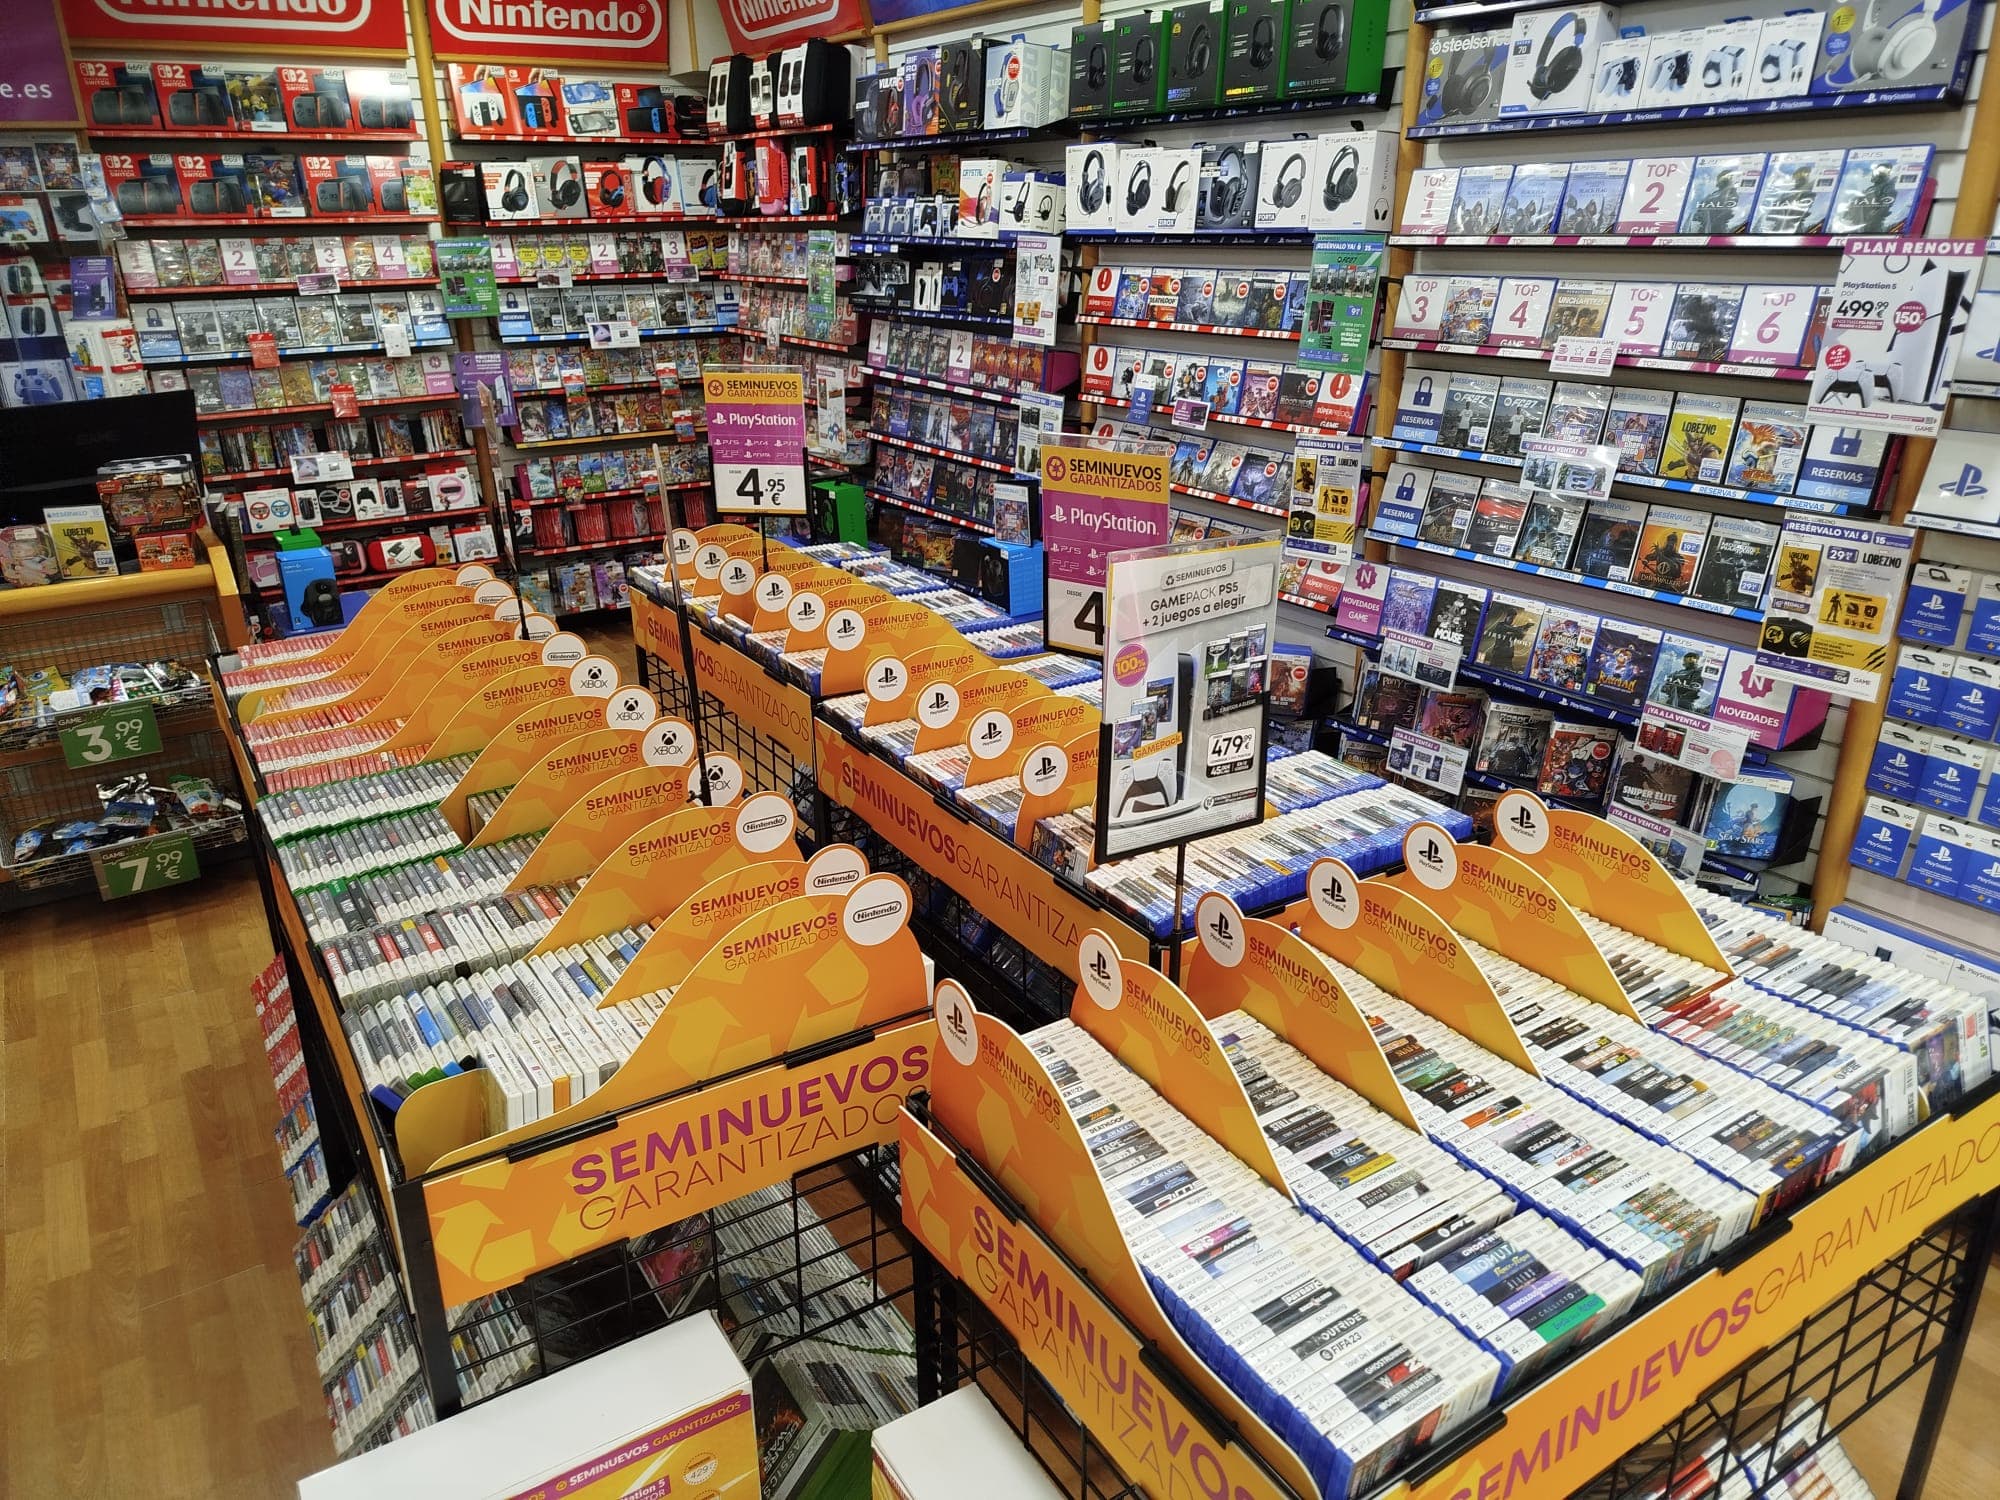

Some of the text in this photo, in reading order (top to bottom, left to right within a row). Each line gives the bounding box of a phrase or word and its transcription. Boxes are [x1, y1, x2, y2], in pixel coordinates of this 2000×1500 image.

[460, 0, 642, 33] Nintendo
[96, 63, 109, 77] 2
[173, 64, 186, 79] 2
[296, 69, 308, 83] 2
[121, 156, 133, 170] 2
[194, 157, 207, 171] 2
[321, 157, 333, 171] 2
[1646, 163, 1678, 178] TOP
[1639, 182, 1666, 214] 2
[225, 240, 246, 248] TOP
[381, 244, 395, 260] 4
[496, 243, 507, 258] 1
[598, 241, 610, 257] 2
[669, 238, 679, 255] 3
[1851, 241, 1976, 255] PLAN RENOVE
[232, 249, 246, 267] 2
[1414, 280, 1438, 293] TOP
[1514, 284, 1540, 298] TOP
[1630, 288, 1660, 302] TOP
[1843, 282, 1897, 291] PlayStation 5
[1411, 296, 1430, 323] 3
[1761, 292, 1797, 307] TOP
[1508, 300, 1528, 329] 4
[1624, 305, 1648, 336] 5
[1756, 311, 1782, 344] 6
[955, 345, 964, 364] 2
[726, 379, 799, 390] SEMINUEVOS
[727, 390, 799, 399] GARANTIZADOS
[729, 413, 798, 429] PlayStation
[1400, 414, 1435, 427] RESERVAS
[1403, 429, 1426, 439] GAME
[1069, 458, 1162, 481] SEMINUEVOS
[1811, 466, 1864, 483] RESERVAS
[1069, 472, 1162, 493] GARANTIZADOS
[1814, 487, 1849, 500] GAME
[1383, 508, 1415, 520] RESERVAS
[1783, 499, 1825, 511] RESERVAS
[1070, 505, 1158, 536] PlayStation
[1786, 522, 1886, 545] ¡RESÉRVALO YA! 15
[1830, 550, 1844, 560] 29
[1175, 563, 1227, 582] SEMINUEVOS
[387, 579, 453, 596] SEMINUEVOS
[794, 575, 853, 591] SEMINUEVOS
[403, 595, 472, 613] SEMINUEVOS
[828, 593, 888, 610] SEMINUEVOS
[1150, 581, 1239, 612] GAMEPACK PS5
[1342, 596, 1380, 612] NOVEDADES
[867, 611, 929, 628] SEMINUEVOS
[1073, 590, 1104, 646] 4
[1152, 593, 1247, 630] 2 juegos elegir
[1348, 610, 1369, 624] GAME
[420, 614, 491, 632] SEMINUEVOS
[867, 619, 930, 635] GARANTIZADOS
[437, 631, 512, 652] SEMINUEVOS
[1434, 628, 1464, 645] MOUSE
[461, 651, 539, 673] SEMINUEVOS
[910, 654, 975, 675] SEMINUEVOS
[910, 664, 975, 682] GARANTIZADOS
[483, 676, 567, 702] SEMINUEVOS
[579, 679, 609, 689] XBOX
[961, 677, 1029, 700] SEMINUEVOS
[485, 686, 568, 710] GARANTIZADOS
[714, 660, 810, 744] GARANTIZADOS
[962, 689, 1029, 709] GARANTIZADOS
[57, 715, 83, 727] GAME
[515, 708, 602, 734] SEMINUEVOS
[615, 711, 646, 721] XBOX
[1015, 704, 1086, 729] SEMINUEVOS
[1674, 714, 1702, 728] VENTA!
[1719, 704, 1780, 728] NOVEDADES
[517, 718, 603, 743] GARANTIZADOS
[1016, 717, 1086, 738] GARANTIZADOS
[547, 743, 639, 772] SEMINUEVOS
[653, 744, 684, 756] XBOX
[549, 753, 640, 781] GARANTIZADOS
[585, 779, 683, 811] SEMINUEVOS
[587, 789, 685, 821] GARANTIZADOS
[1622, 786, 1678, 804] SNIPER ELITE
[842, 760, 956, 864] SEMINUEVOS
[746, 815, 786, 834] Nintendo
[628, 821, 732, 857] SEMINUEVOS
[1553, 824, 1652, 872] SEMINUEVOS
[1718, 831, 1765, 846] SEA STARS
[102, 849, 126, 861] GAME
[629, 832, 732, 868] GARANTIZADOS
[1552, 836, 1650, 883] GARANTIZADOS
[817, 871, 859, 887] Nintendo
[1461, 859, 1558, 913] SEMINUEVOS
[690, 877, 800, 915] SEMINUEVOS
[1461, 871, 1557, 924] GARANTIZADOS
[857, 902, 902, 924] Nintendo
[722, 911, 839, 959] SEMINUEVOS
[1364, 898, 1458, 957] SEMINUEVOS
[725, 925, 840, 971] GARANTIZADOS
[1363, 912, 1457, 969] GARANTIZADOS
[1248, 936, 1340, 1001] SEMINUEVOS
[1248, 950, 1340, 1014] GARANTIZADOS
[1126, 978, 1212, 1053] SEMINUEVOS
[1126, 992, 1211, 1066] GARANTIZADOS
[981, 1032, 1062, 1116] SEMINUEVOS
[981, 1049, 1061, 1131] GARANTIZADOS
[571, 1045, 931, 1197] SEMINUEVOS
[578, 1083, 932, 1232] GARANTIZADO
[1332, 1332, 1362, 1356] FIFA 23
[569, 1400, 742, 1487] SEMINUEVOS GARANTIZADOS
